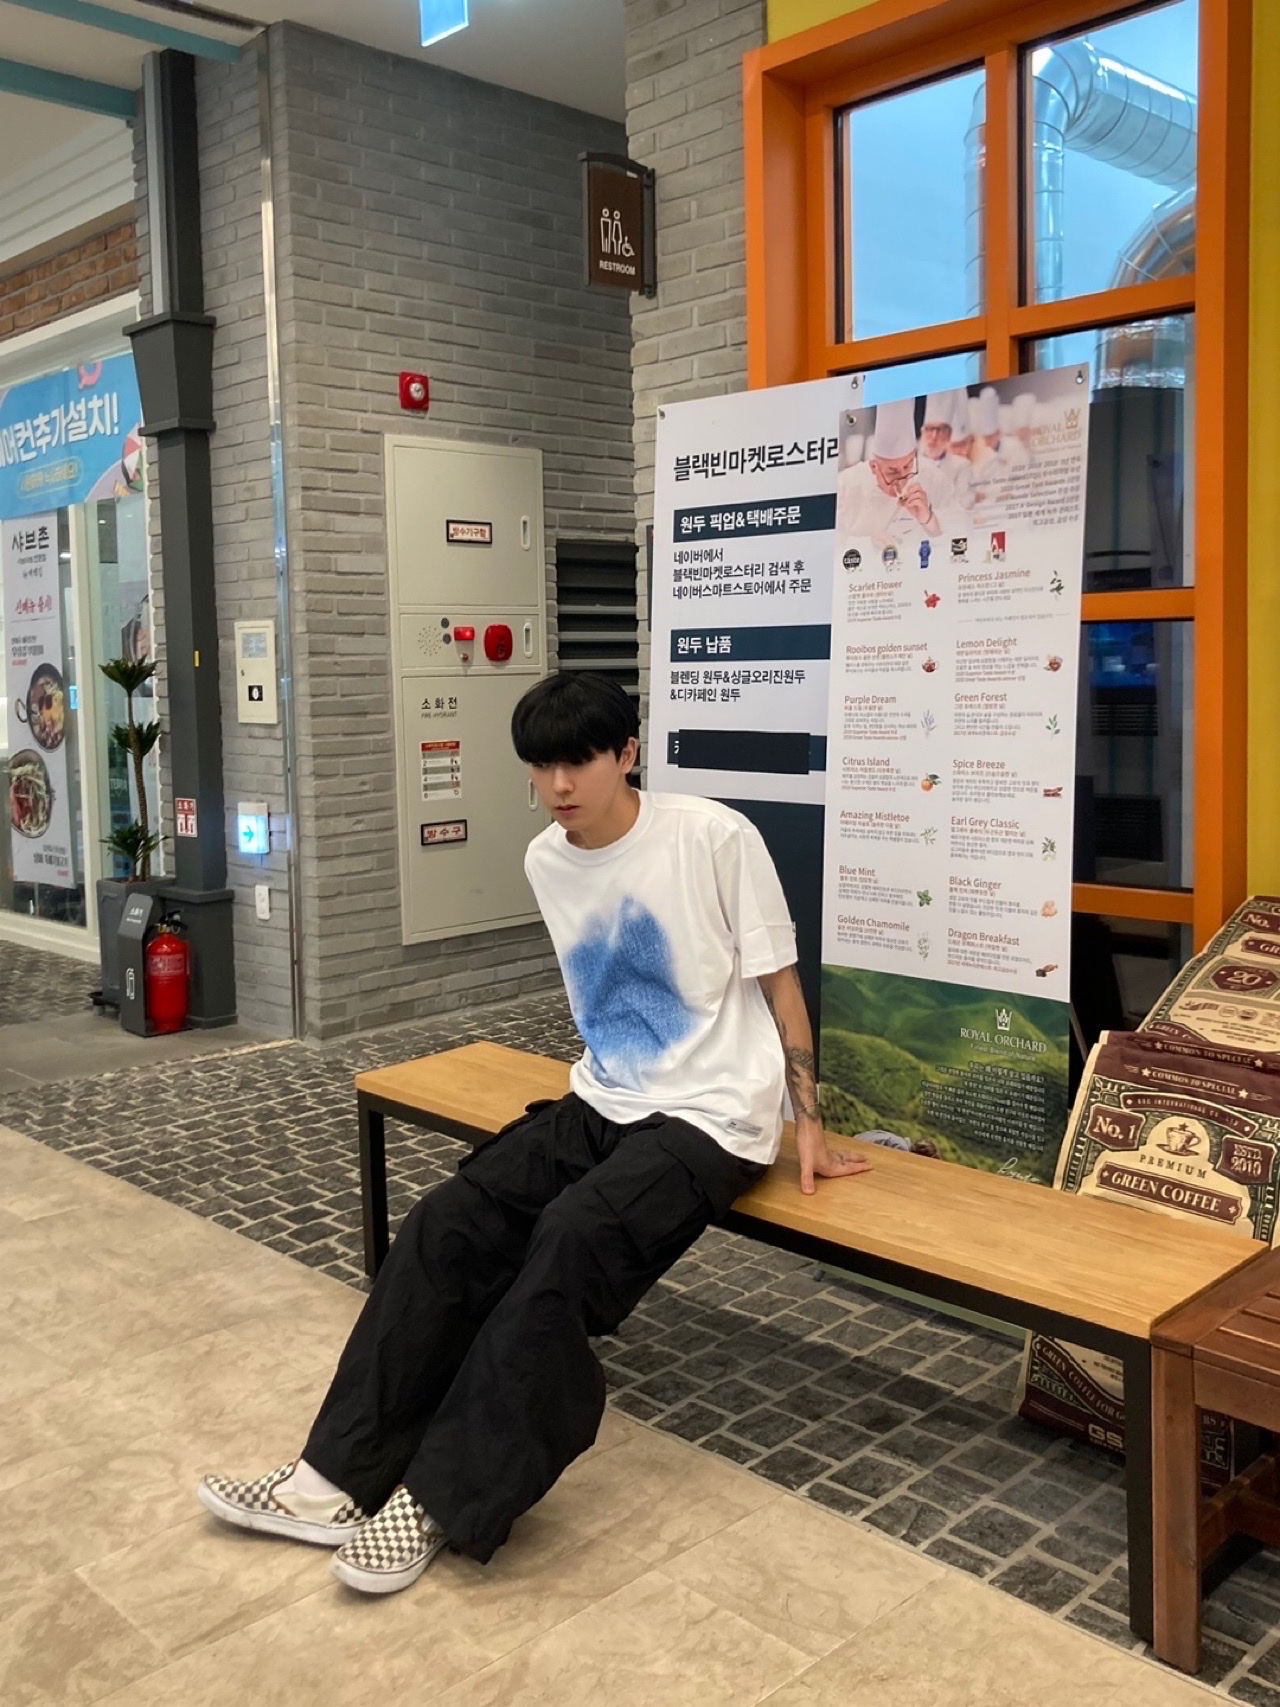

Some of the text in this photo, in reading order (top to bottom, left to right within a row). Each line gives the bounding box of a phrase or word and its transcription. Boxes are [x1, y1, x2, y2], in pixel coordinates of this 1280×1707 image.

[599, 259, 636, 276] RESTROOM
[680, 505, 801, 534] 원두 픽업&택배주문
[11, 525, 50, 553] 샤브촌
[673, 548, 724, 565] 네이버에서
[672, 560, 805, 583] 블랙빈마켓로스터리 검색 후
[958, 568, 1031, 582] Princess Jasmine
[672, 578, 812, 600] 네이버스마트스토어에서 주문
[848, 580, 903, 592] Scarlet Flower
[677, 635, 732, 654] 원두 납품
[846, 642, 928, 656] Rooibos golden sunset
[955, 637, 1017, 649] Lemon Delight
[670, 669, 806, 685] 블렌딩 원두&싱글오리진원두
[669, 688, 741, 702] &디카페인 원두
[844, 695, 897, 706] Purple Dream
[954, 692, 1008, 702] Green Forest
[842, 756, 890, 766] Citrus Island
[952, 759, 1006, 770] Spice Breeze
[840, 810, 911, 822] Amazing Mistletoe
[951, 816, 1020, 829] Earl Grey Classic
[839, 865, 876, 876] Blue Mint
[949, 876, 1001, 891] Black Ginger
[837, 914, 910, 932] Golden Chamomile
[1243, 913, 1271, 929] No.
[947, 928, 1020, 946] Dragon Breakfast
[1226, 970, 1262, 986] 20
[960, 1027, 1047, 1054] ROYAL ORCHARD
[1163, 1043, 1202, 1058] COMMON
[1203, 1050, 1216, 1060] TO
[1151, 1069, 1237, 1095] COMMON TO SPECIAL
[1093, 1115, 1136, 1141] No. 1
[1139, 1154, 1208, 1179] PREMIUM
[1230, 1155, 1262, 1177] 2010
[1111, 1171, 1222, 1213] GREEN COFFEE
[1068, 1370, 1096, 1402] COFFEE
